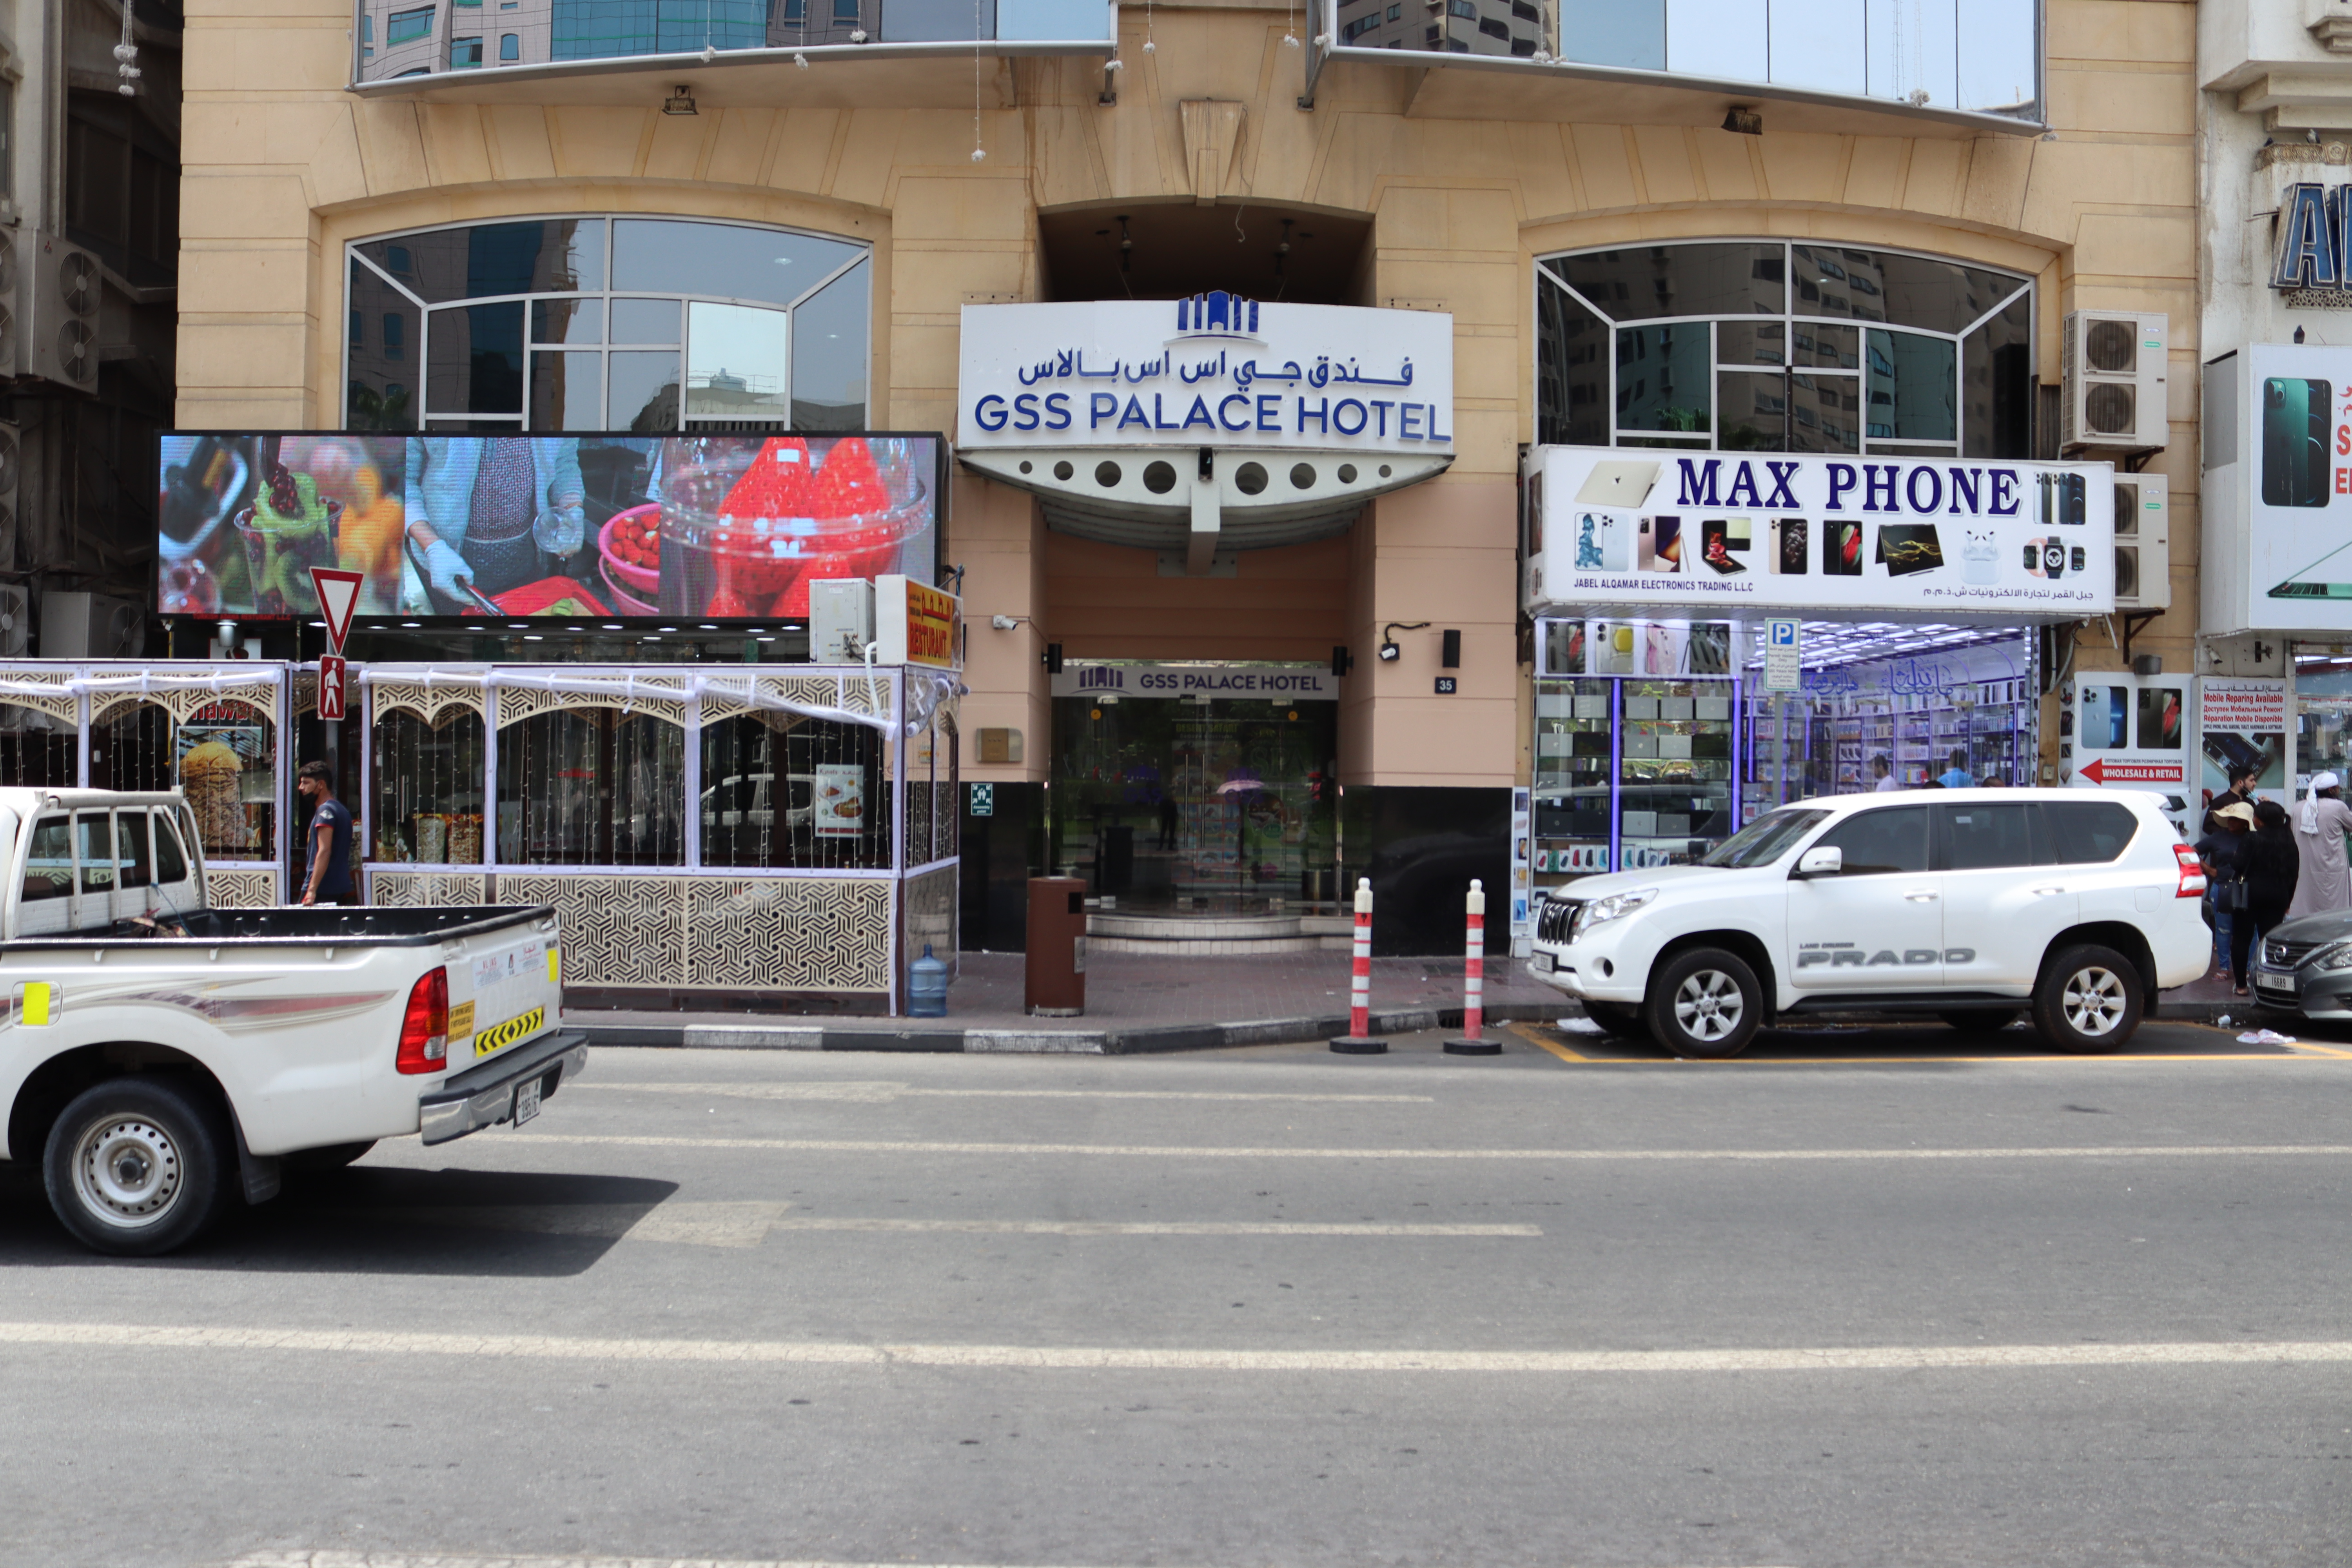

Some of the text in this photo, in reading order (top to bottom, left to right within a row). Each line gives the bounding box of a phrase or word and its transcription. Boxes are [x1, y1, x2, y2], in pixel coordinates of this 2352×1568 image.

[1019, 347, 1413, 392] فندق جي اس اس بالاس
[975, 393, 1452, 442] GSS PALACE HOTEL
[1677, 458, 2022, 515] MAX PHONE
[1574, 578, 1753, 592] JABEL ALQAMAR ELECTRONICS TRADING L.L.C
[2024, 589, 2050, 600] لتجارة
[2052, 589, 2074, 599] القمر
[2076, 590, 2094, 601] جبل
[909, 621, 947, 659] RESTURANT
[1776, 624, 1791, 644] P
[1140, 673, 1323, 691] GSS PALACE HOTEL
[1439, 680, 1452, 691] 35
[2204, 693, 2283, 704] Mobile Reparing Available
[2203, 705, 2229, 713] Доступен
[2204, 714, 2233, 723] Réparation
[2255, 715, 2283, 724] Disponible
[2102, 768, 2181, 779] WHOLESALE & RETAIL
[1797, 948, 1976, 969] PRADO
[2272, 975, 2286, 988] 16689
